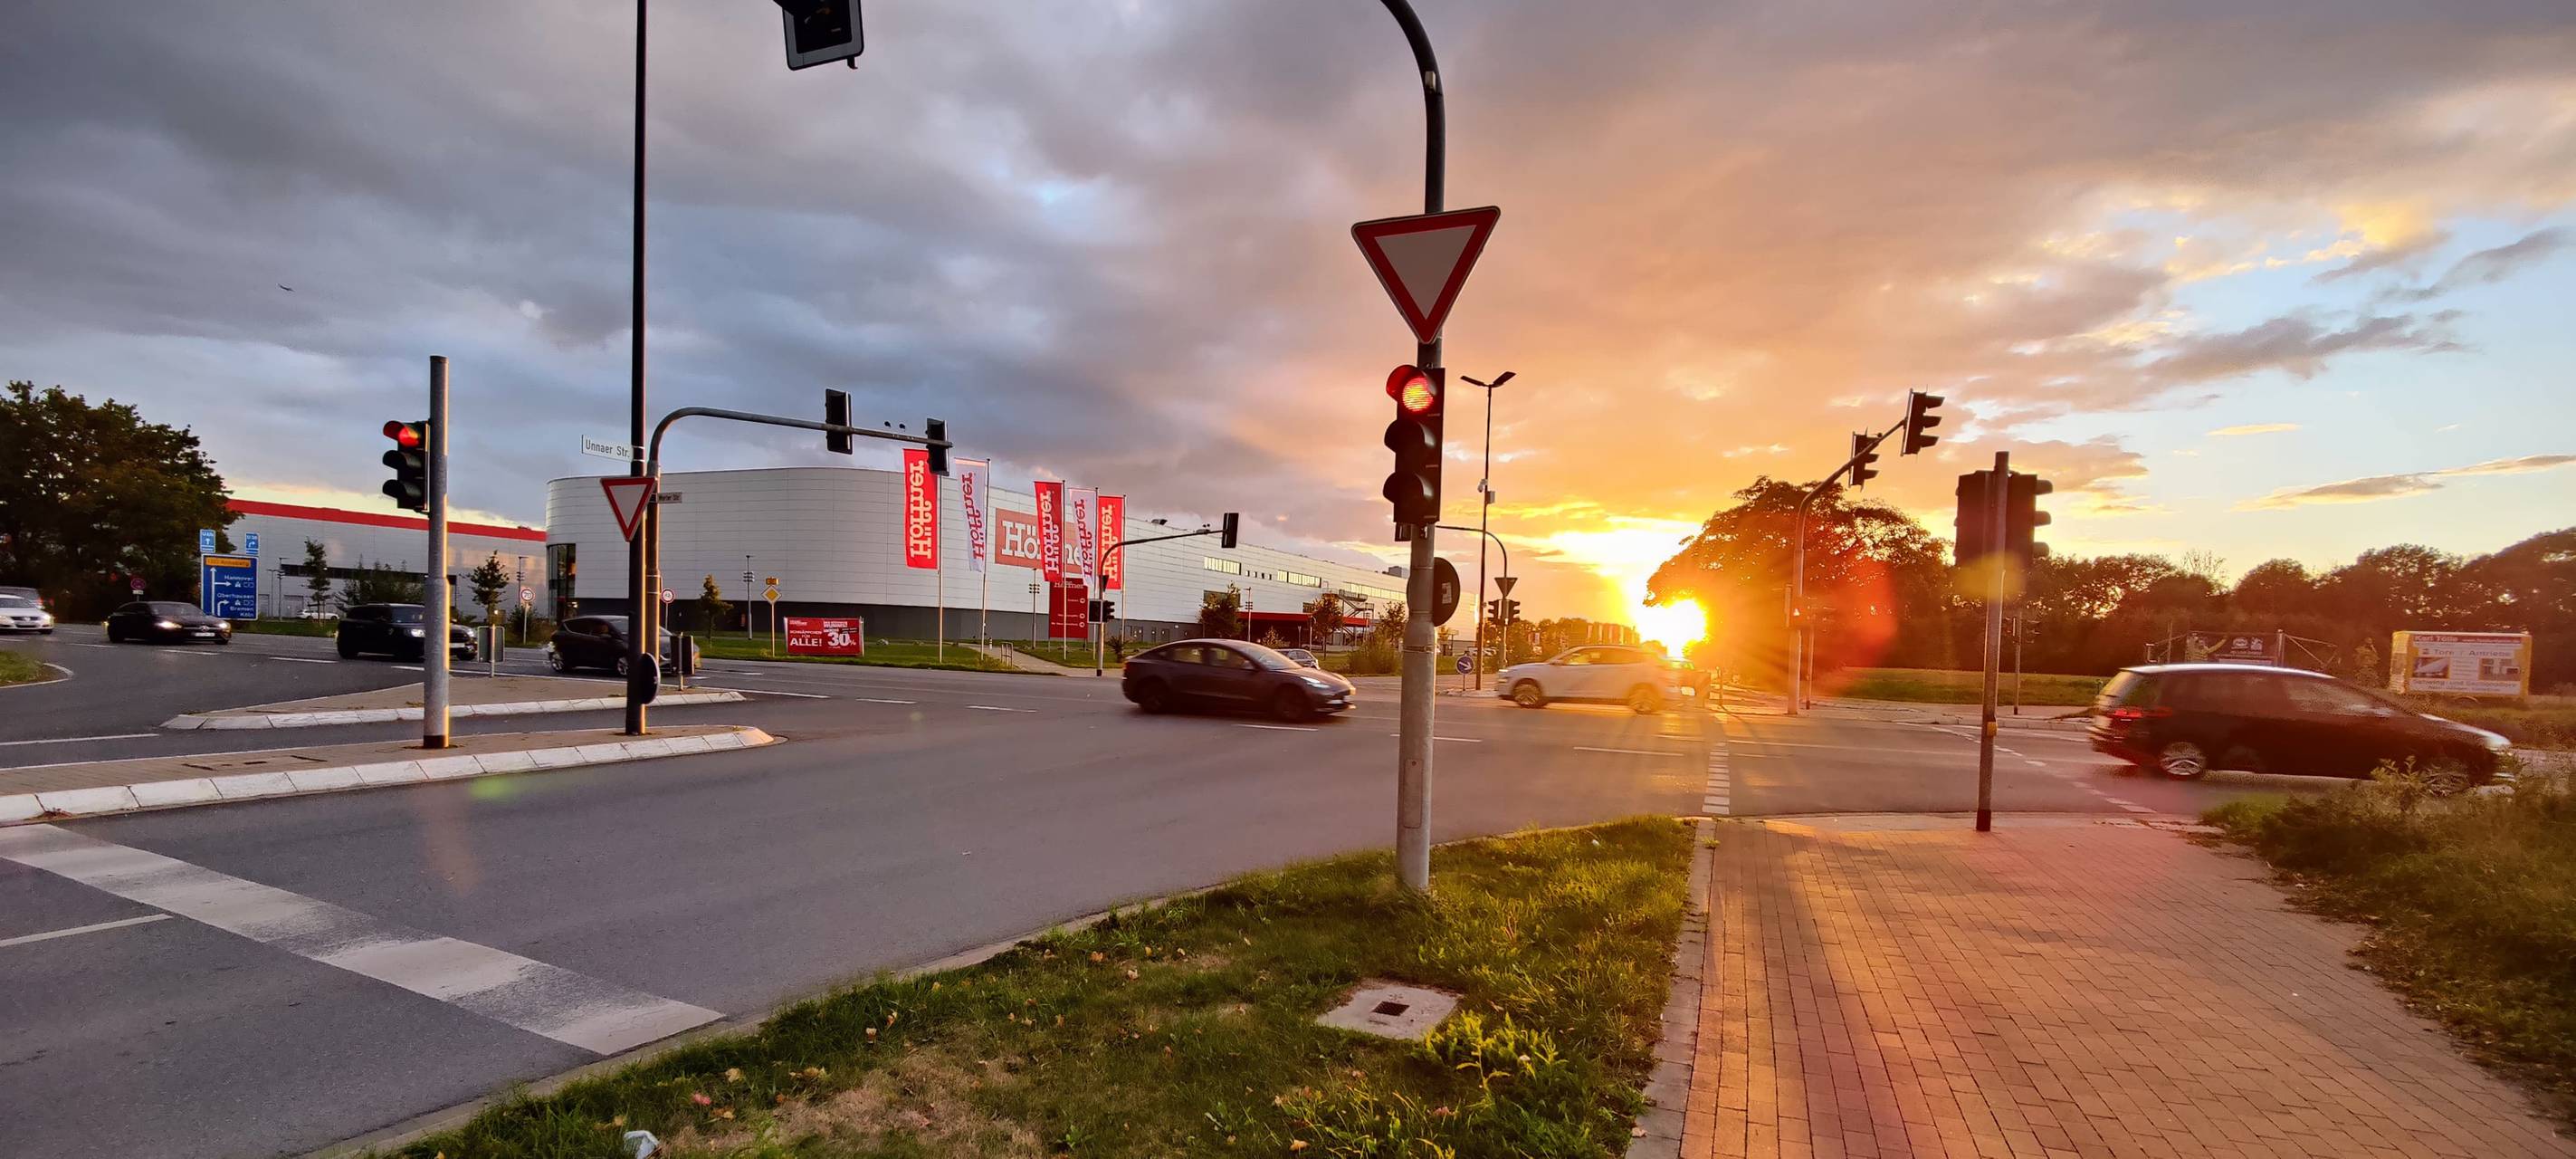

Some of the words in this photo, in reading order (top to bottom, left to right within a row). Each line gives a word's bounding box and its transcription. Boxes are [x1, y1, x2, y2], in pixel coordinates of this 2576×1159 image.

[586, 439, 613, 454] Unnaer
[616, 446, 630, 458] Str.
[789, 637, 822, 647] ALLE!
